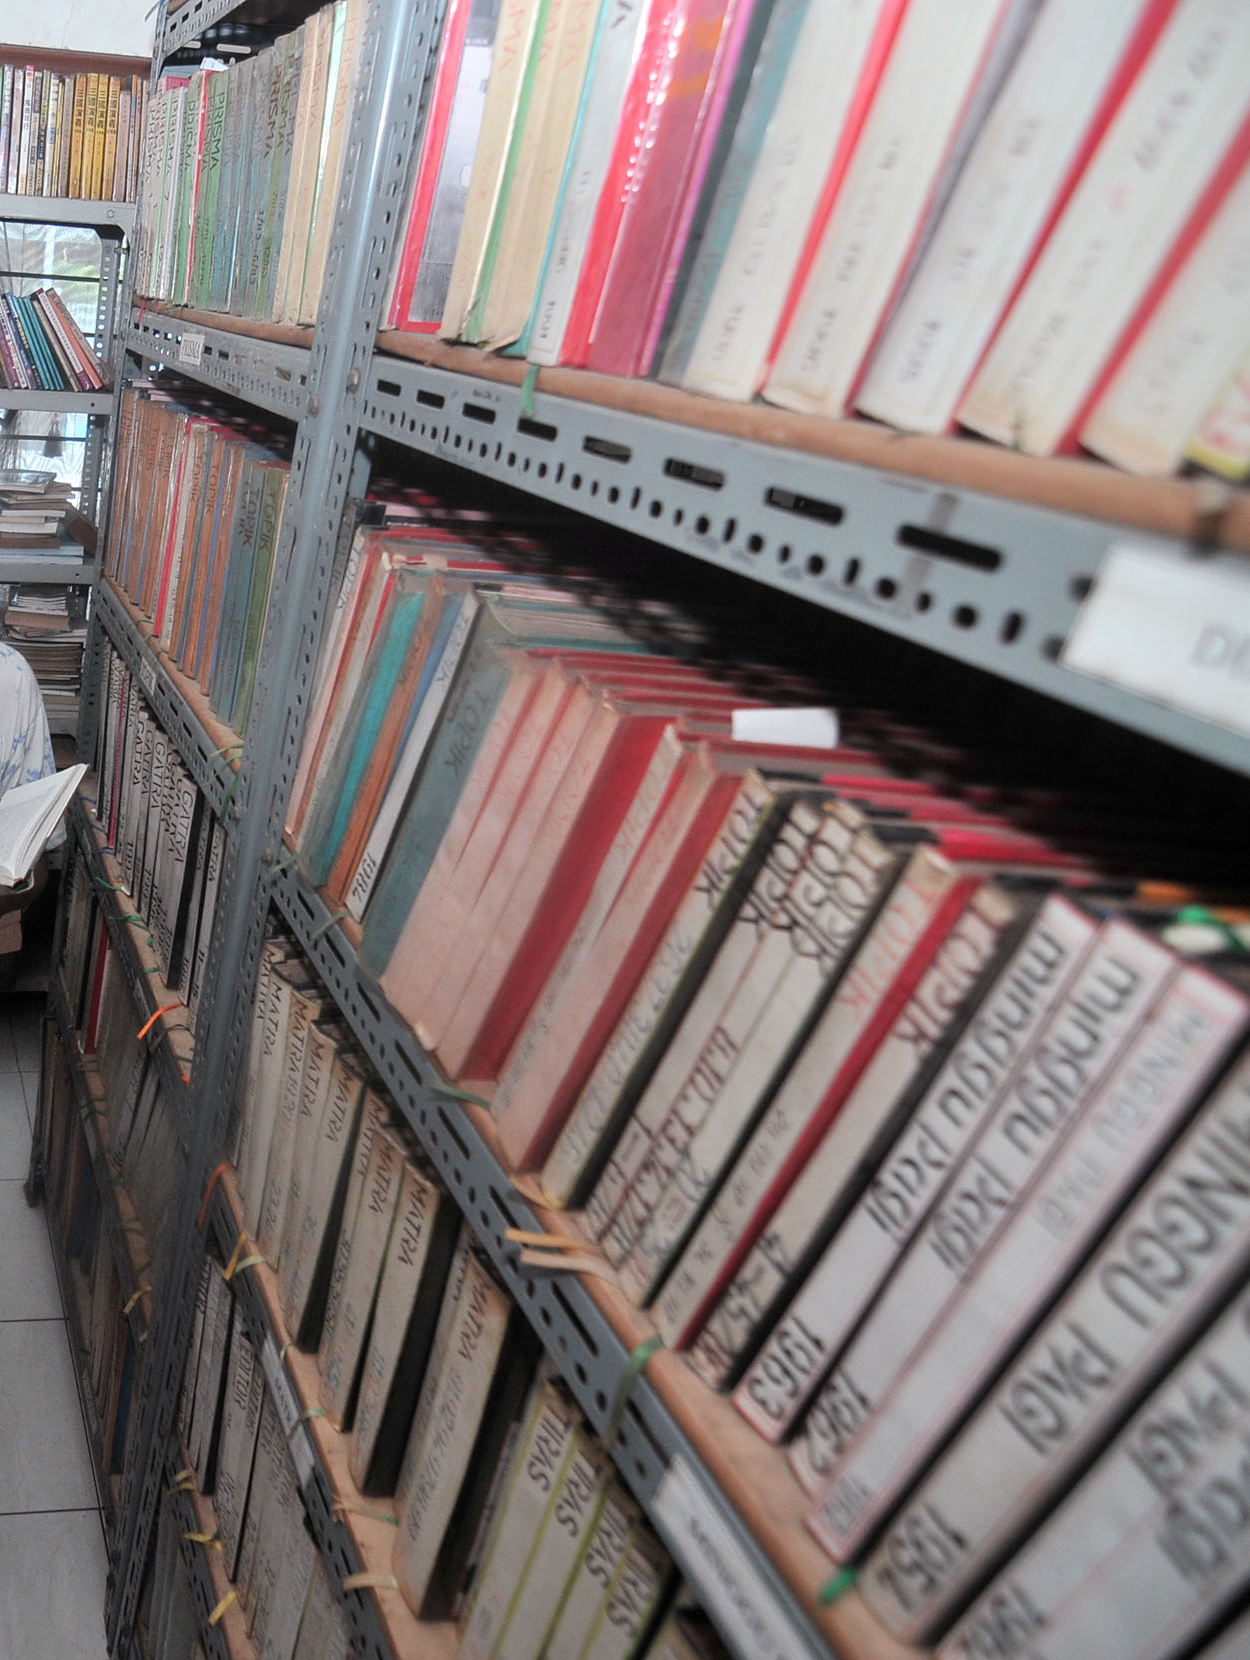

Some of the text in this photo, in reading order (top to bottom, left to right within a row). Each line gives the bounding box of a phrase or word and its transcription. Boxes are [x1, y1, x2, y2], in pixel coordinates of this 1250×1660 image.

[210, 91, 226, 172] PRISMA
[263, 63, 282, 159] PRISMA
[183, 337, 203, 362] PRISMA
[243, 487, 260, 546] TOPIK
[260, 488, 278, 550] TOPIK
[133, 721, 146, 787] GATRA
[151, 741, 166, 810] GATRA
[445, 691, 493, 776] TOPIK
[175, 790, 194, 864] GATRA
[695, 783, 763, 912] TOPIK
[262, 981, 284, 1057] MATRA
[890, 903, 1006, 1058] TOPIK
[286, 1001, 310, 1078] MATRA
[298, 1041, 327, 1118] MATRA
[326, 1069, 357, 1144] MATRA
[367, 1143, 397, 1216] MATRA
[751, 930, 1065, 1421] minggu pagi 1963
[805, 956, 1141, 1478] minggu pagi 1962
[397, 1182, 432, 1268] MATRA
[454, 1269, 494, 1364] MATRA
[235, 1341, 255, 1414] EDITOR
[999, 1316, 1121, 1459] PAGI
[526, 1405, 573, 1493] TIRAS
[1123, 1350, 1250, 1498] PAGI
[554, 1449, 605, 1540] TIRAS
[584, 1495, 635, 1592] TIRAS
[877, 1500, 970, 1612] 1954
